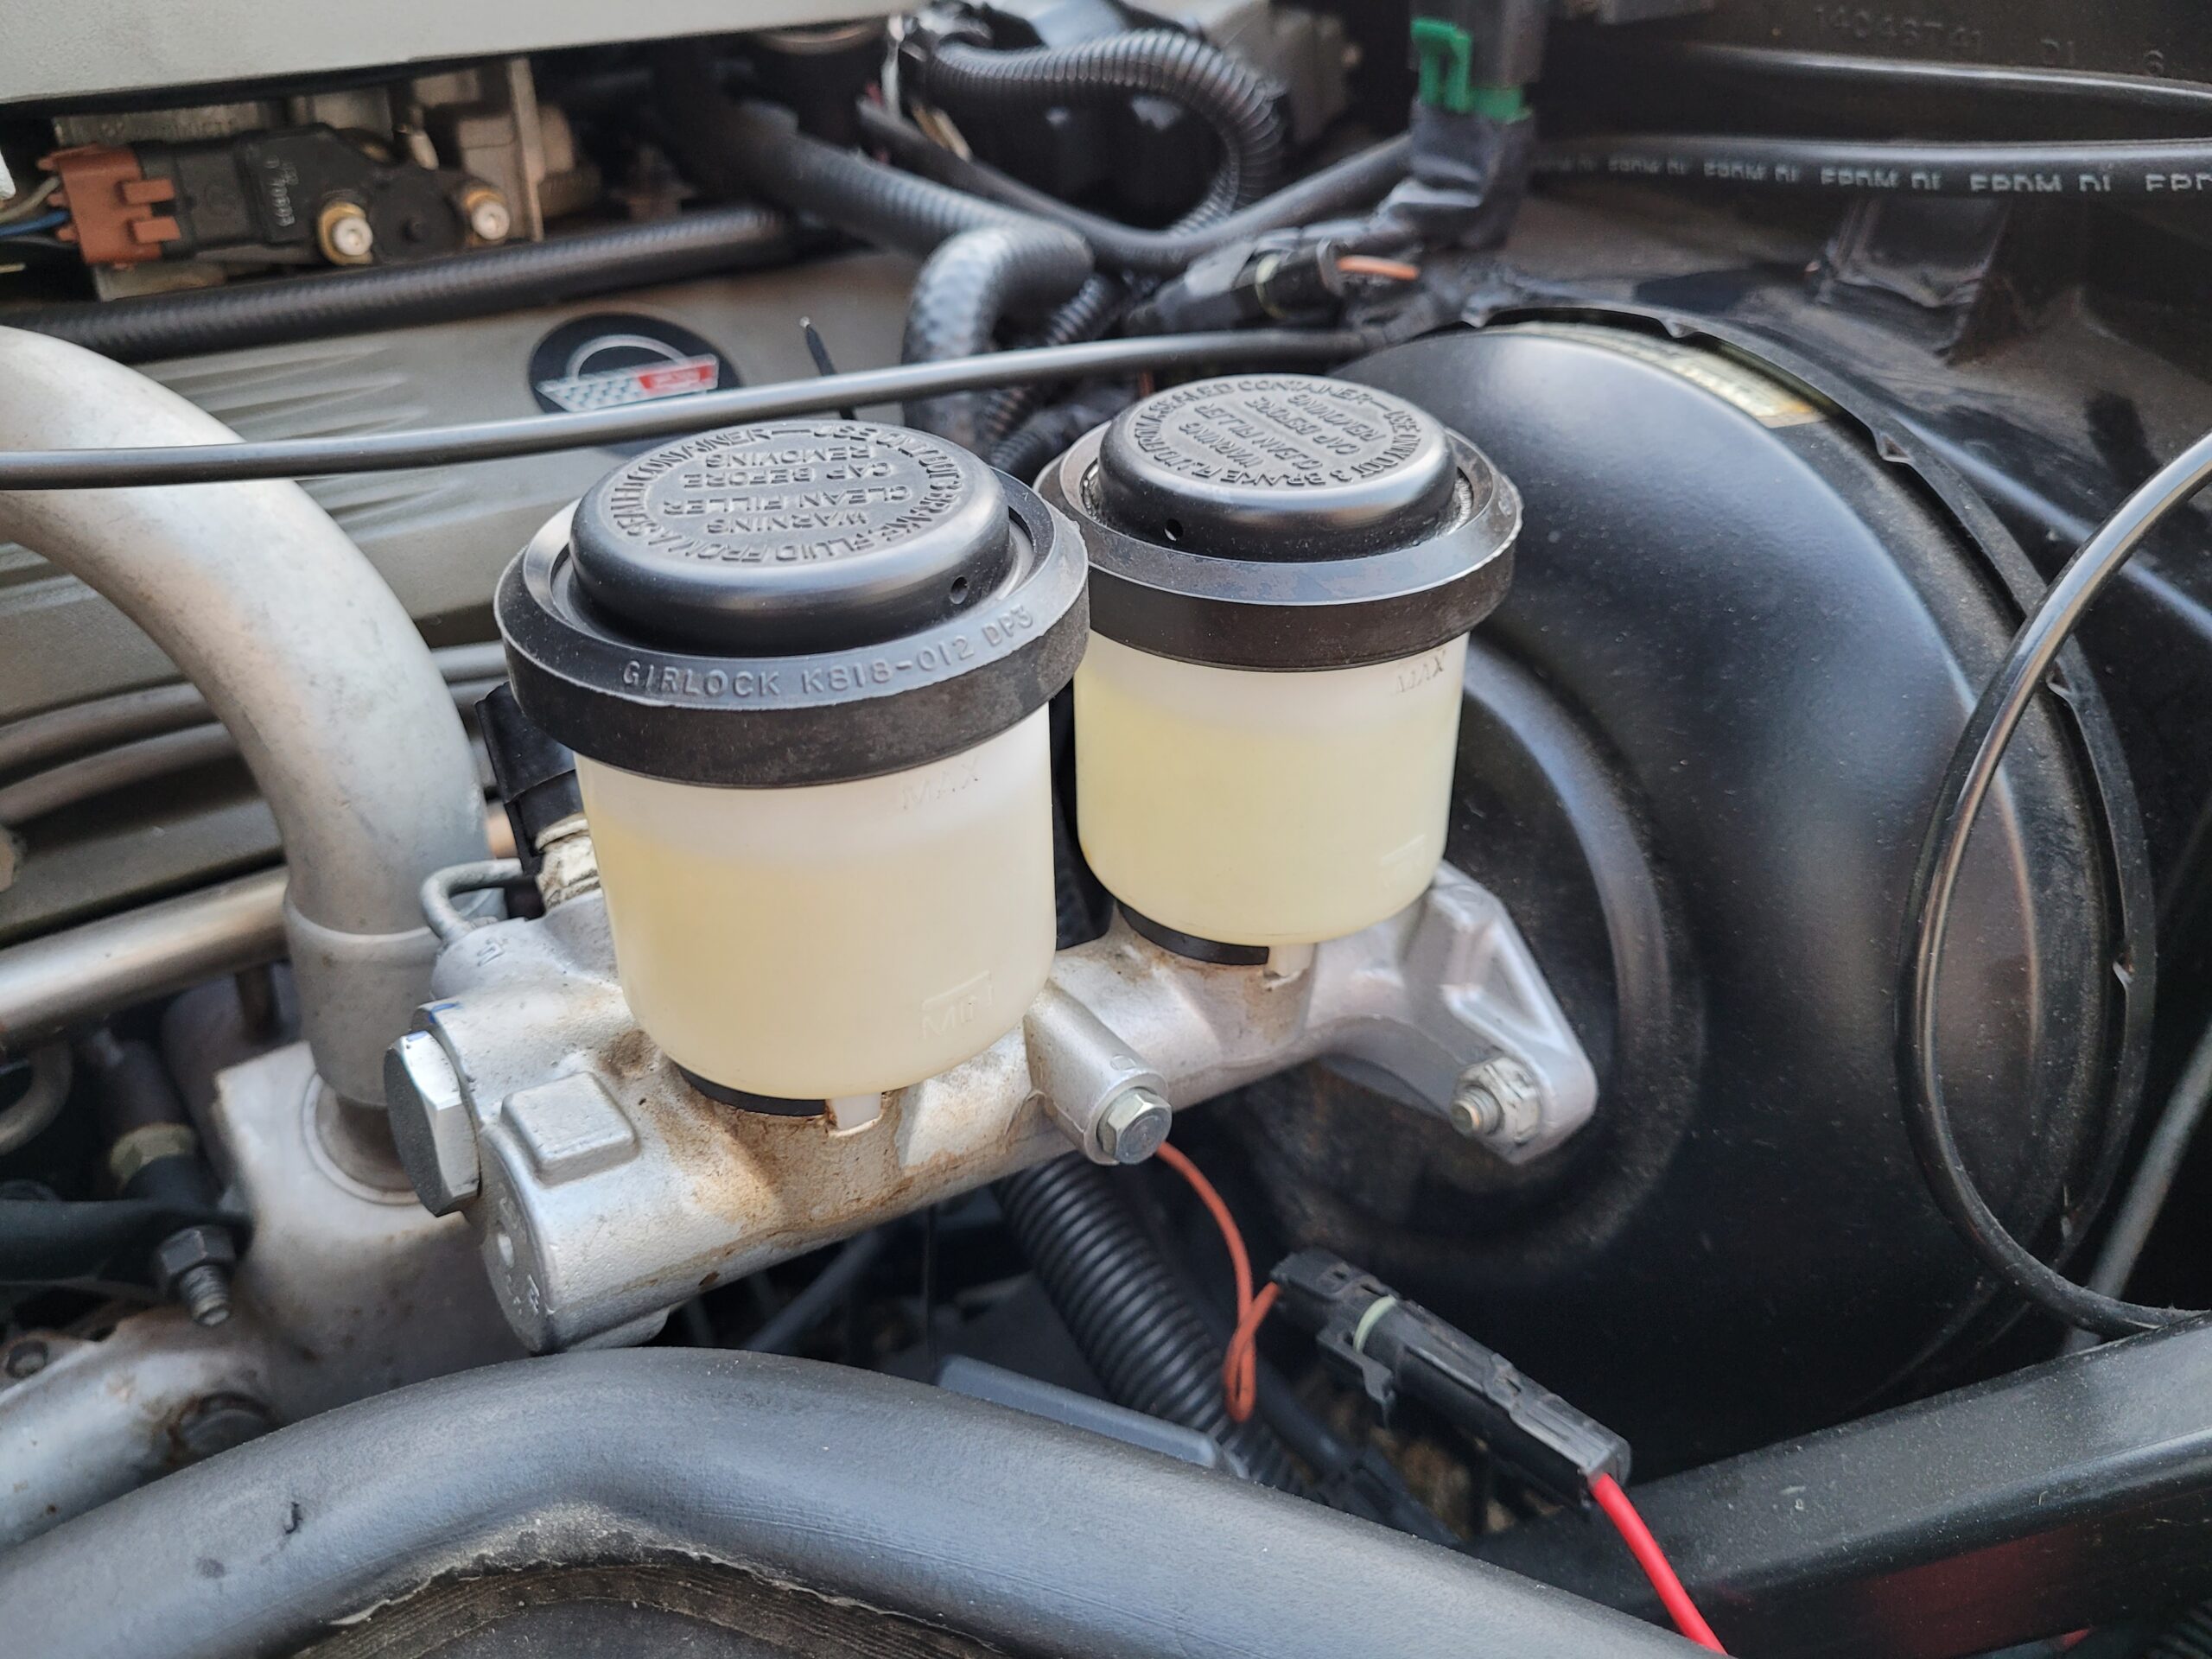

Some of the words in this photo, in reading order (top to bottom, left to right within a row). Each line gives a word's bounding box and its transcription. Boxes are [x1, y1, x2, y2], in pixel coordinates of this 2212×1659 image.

[1237, 380, 1373, 404] CONTAINER
[1194, 403, 1265, 439] FILLER
[1244, 397, 1323, 435] BEFORE
[1287, 393, 1387, 442] REMOVING
[1179, 422, 1264, 468] WARNING
[1252, 436, 1323, 470] CLEAN
[1313, 434, 1361, 454] CAP
[705, 445, 871, 468] REMOVING
[1350, 456, 1399, 478] DOT
[683, 467, 813, 489] BEFORE
[826, 461, 893, 480] CAP
[1220, 469, 1326, 486] BRAKE
[1330, 470, 1352, 482] 3
[663, 494, 783, 516] FILLER
[799, 485, 911, 508] CLEAN
[707, 511, 868, 533] WARNING
[867, 493, 959, 543] BRAKE
[668, 539, 767, 563] FROM
[776, 532, 875, 562] FLUID
[622, 659, 780, 698] GIRLOCK
[801, 635, 976, 693] K818-012
[982, 605, 1034, 646] DP3
[918, 983, 994, 1042] MIN
